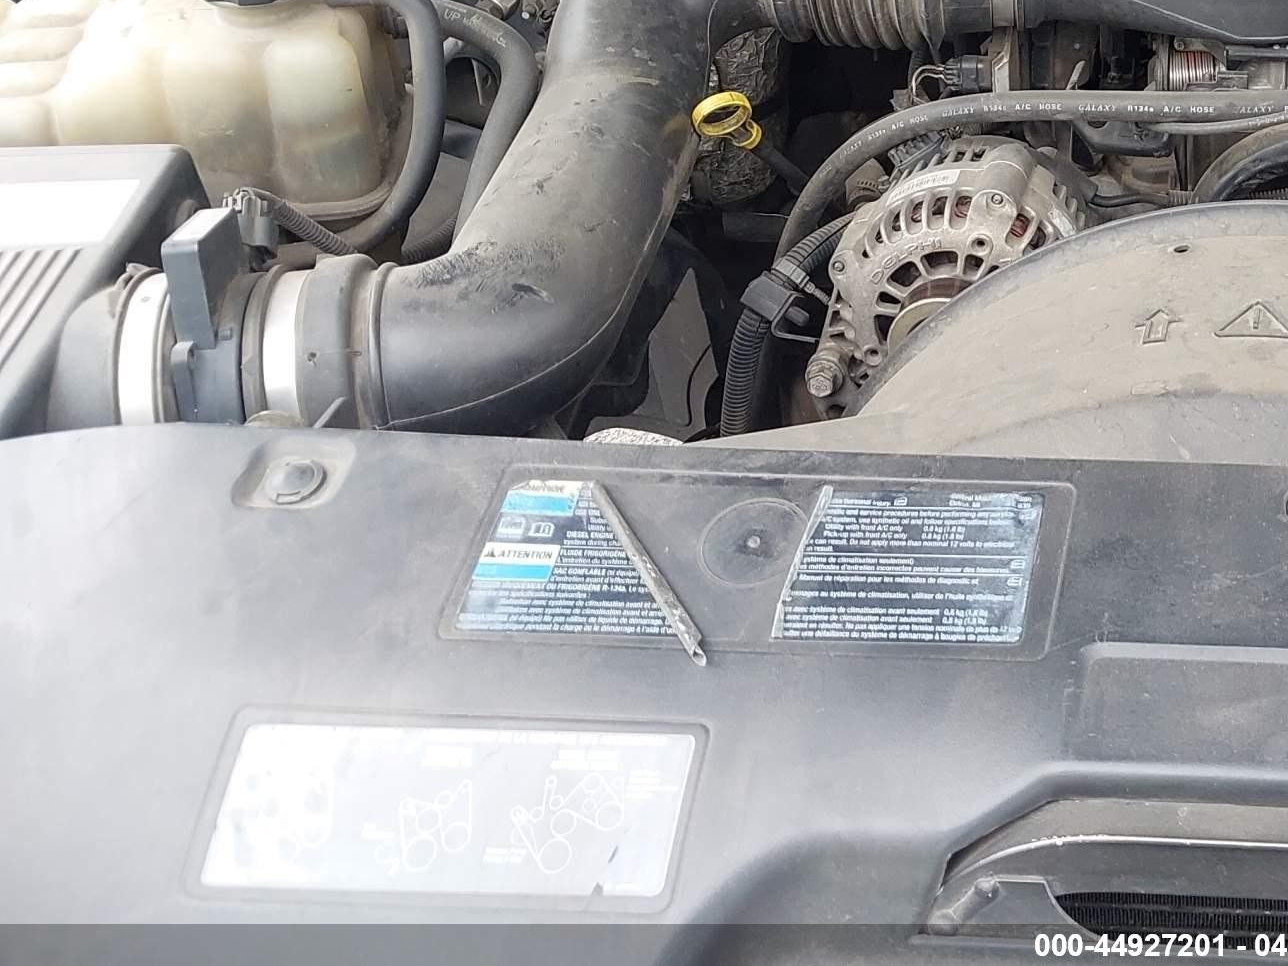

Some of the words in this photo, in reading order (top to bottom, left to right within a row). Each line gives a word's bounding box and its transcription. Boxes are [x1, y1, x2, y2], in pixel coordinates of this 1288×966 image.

[942, 105, 976, 117] GALAXY
[1079, 104, 1118, 112] GALAXY
[1164, 105, 1182, 113] A/C
[499, 550, 553, 560] ATTENTION
